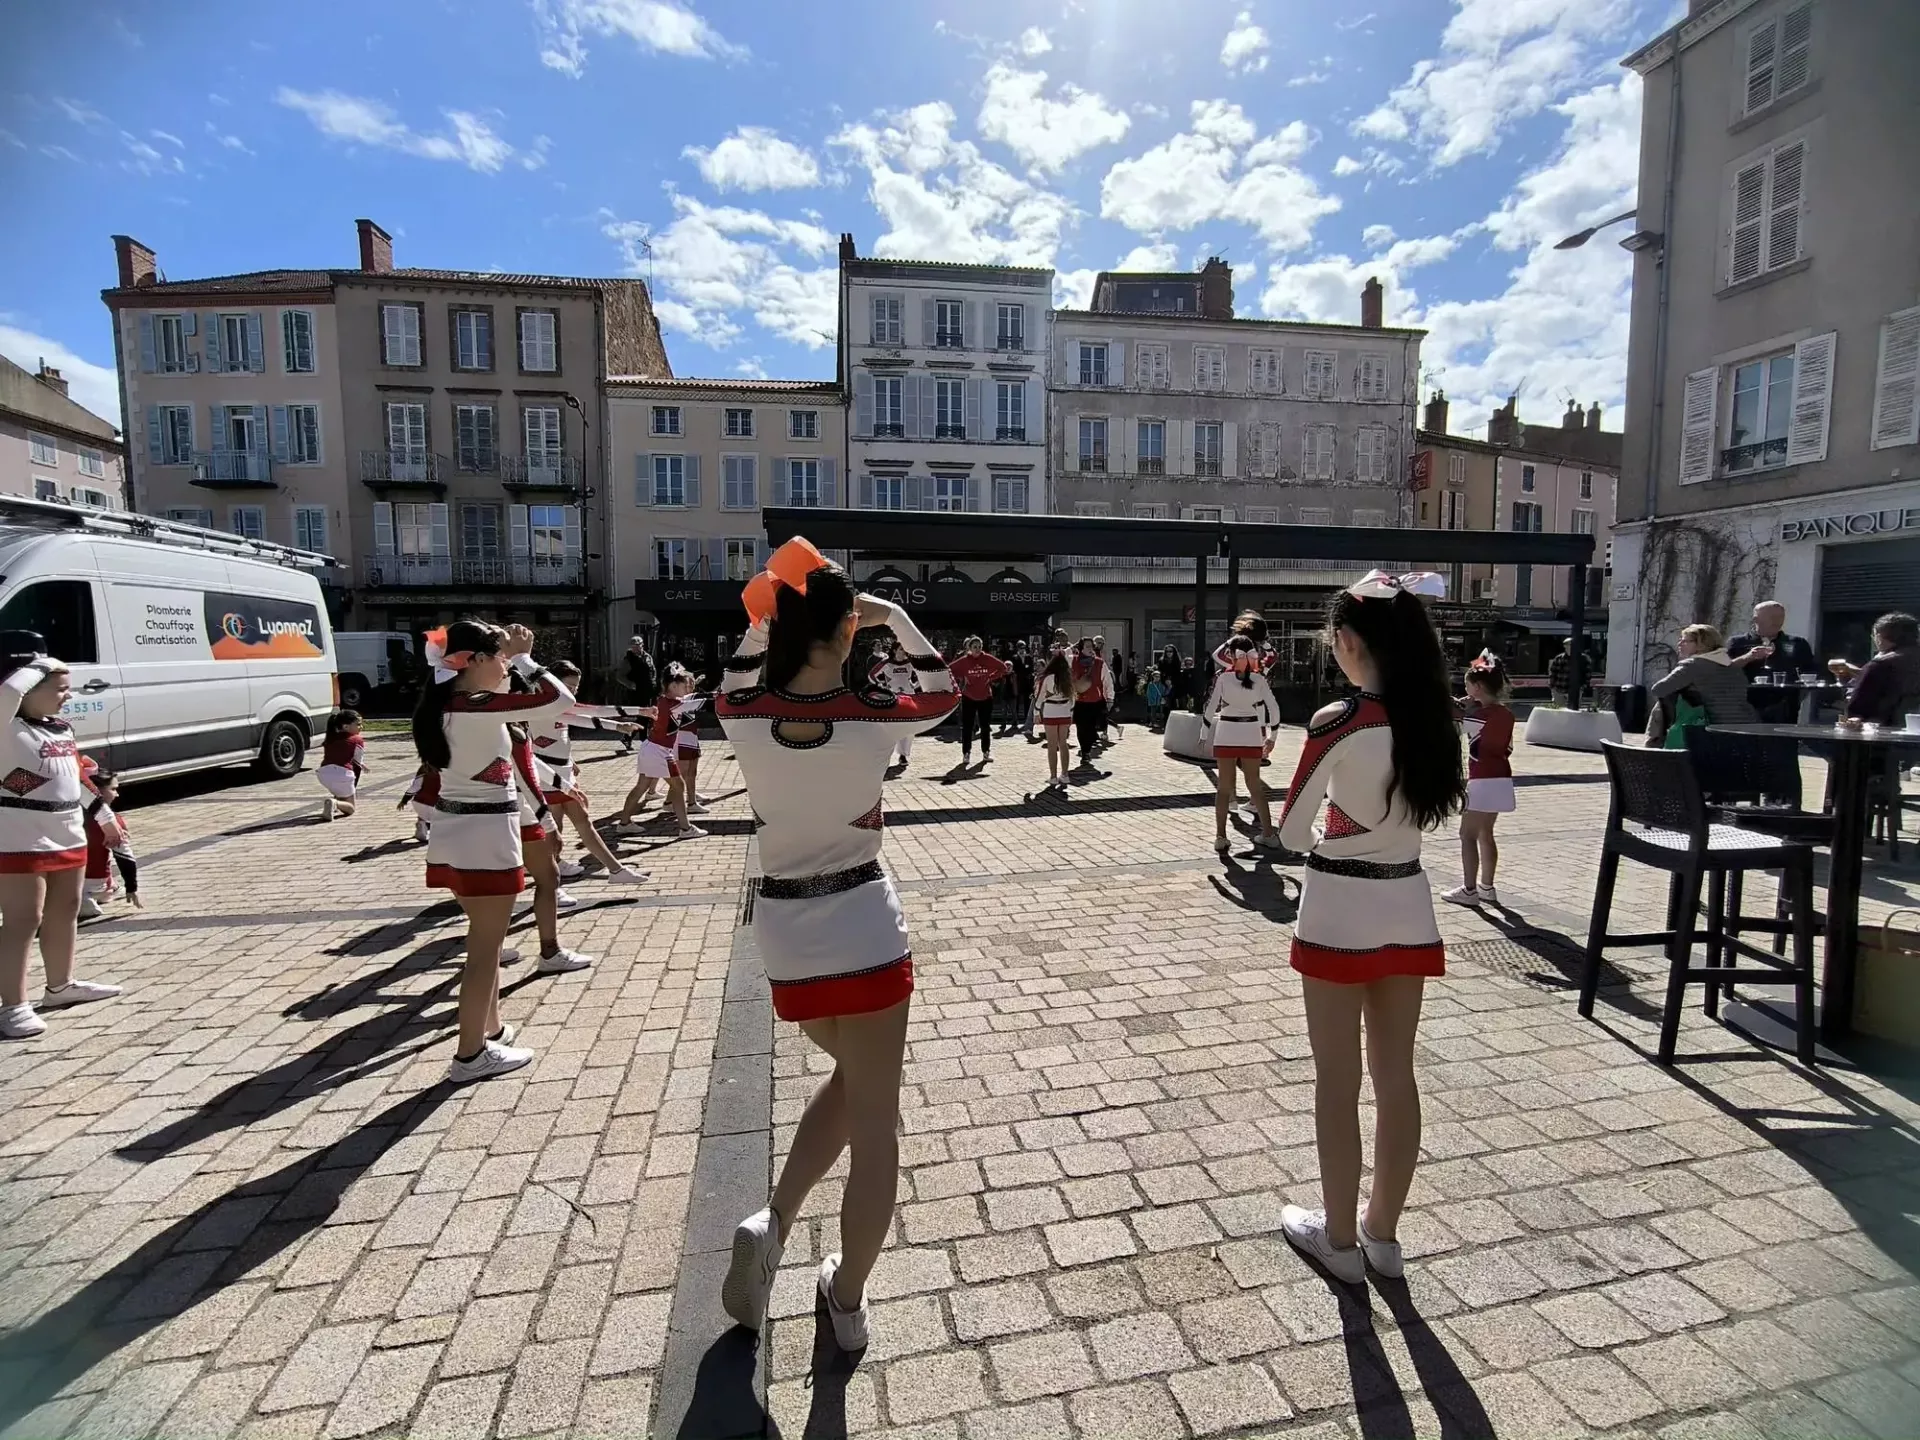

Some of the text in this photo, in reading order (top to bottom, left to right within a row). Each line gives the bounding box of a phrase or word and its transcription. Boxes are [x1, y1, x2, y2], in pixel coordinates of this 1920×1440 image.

[1780, 508, 1920, 542] BANQUE
[664, 589, 703, 600] CAFE
[990, 592, 1060, 603] BRASSERIE
[146, 604, 192, 616] Plomberie
[145, 619, 195, 633] Chauffage
[135, 634, 197, 645] Climatisation
[74, 702, 88, 713] 53
[92, 701, 104, 712] 15
